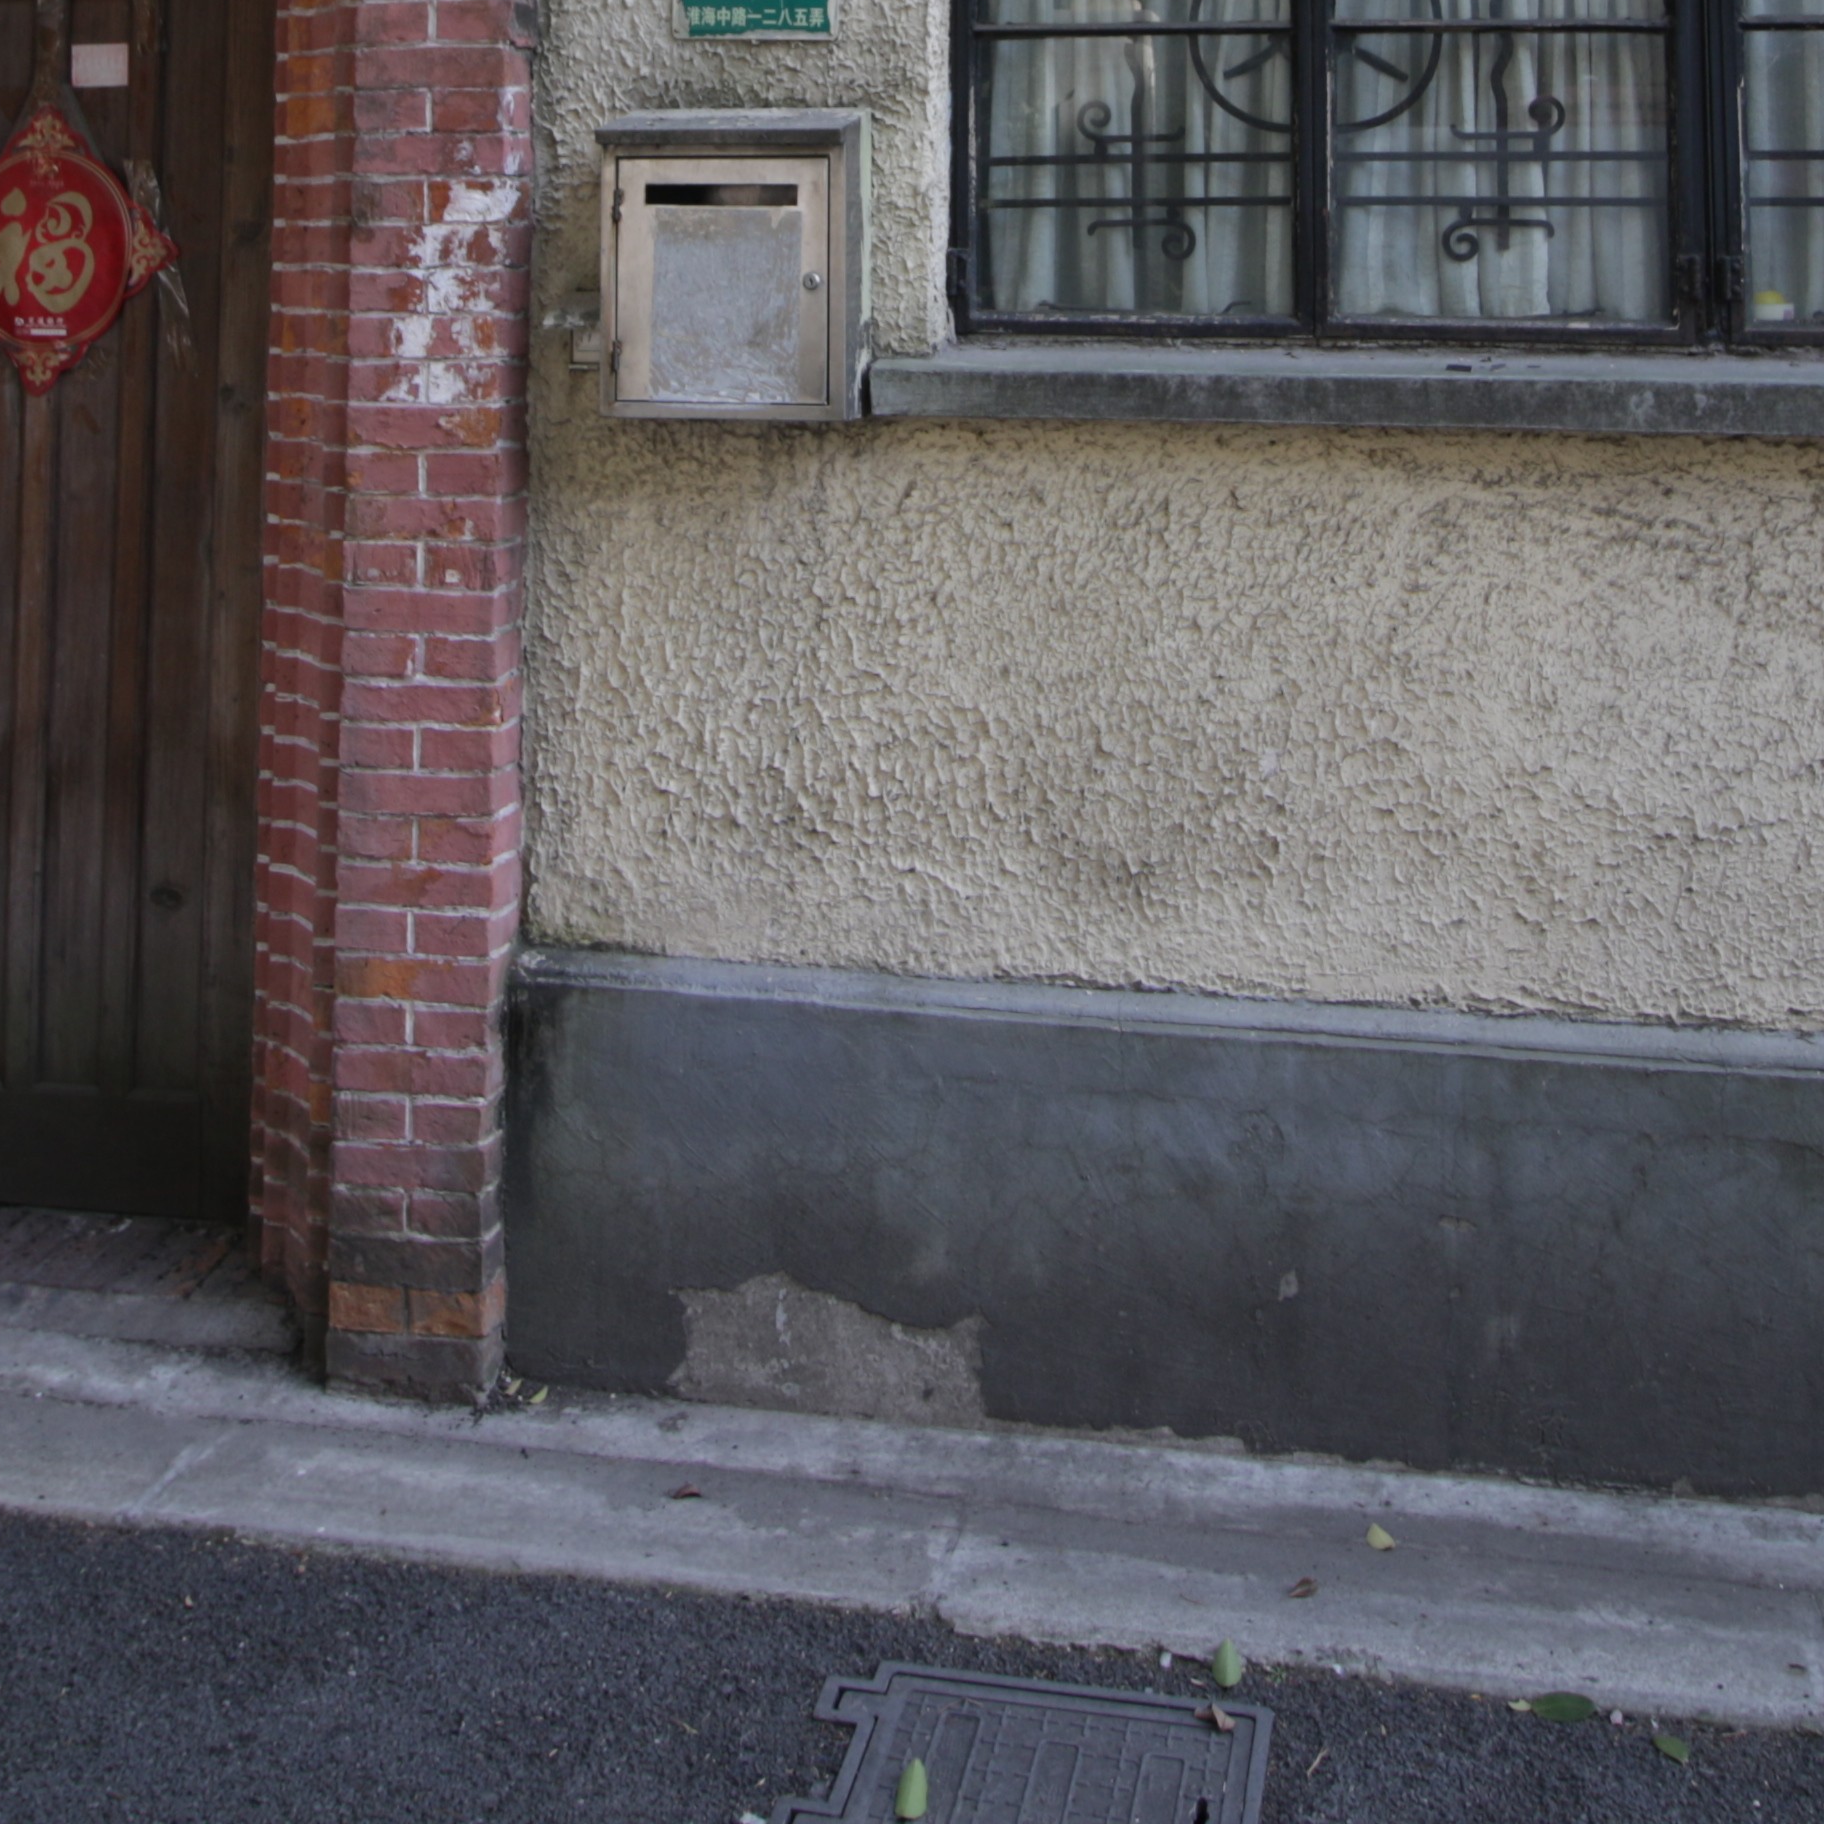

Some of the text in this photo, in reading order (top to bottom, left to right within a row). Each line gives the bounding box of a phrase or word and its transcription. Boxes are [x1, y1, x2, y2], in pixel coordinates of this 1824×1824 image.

[686, 6, 825, 27] 淮海中路一二八五弄
